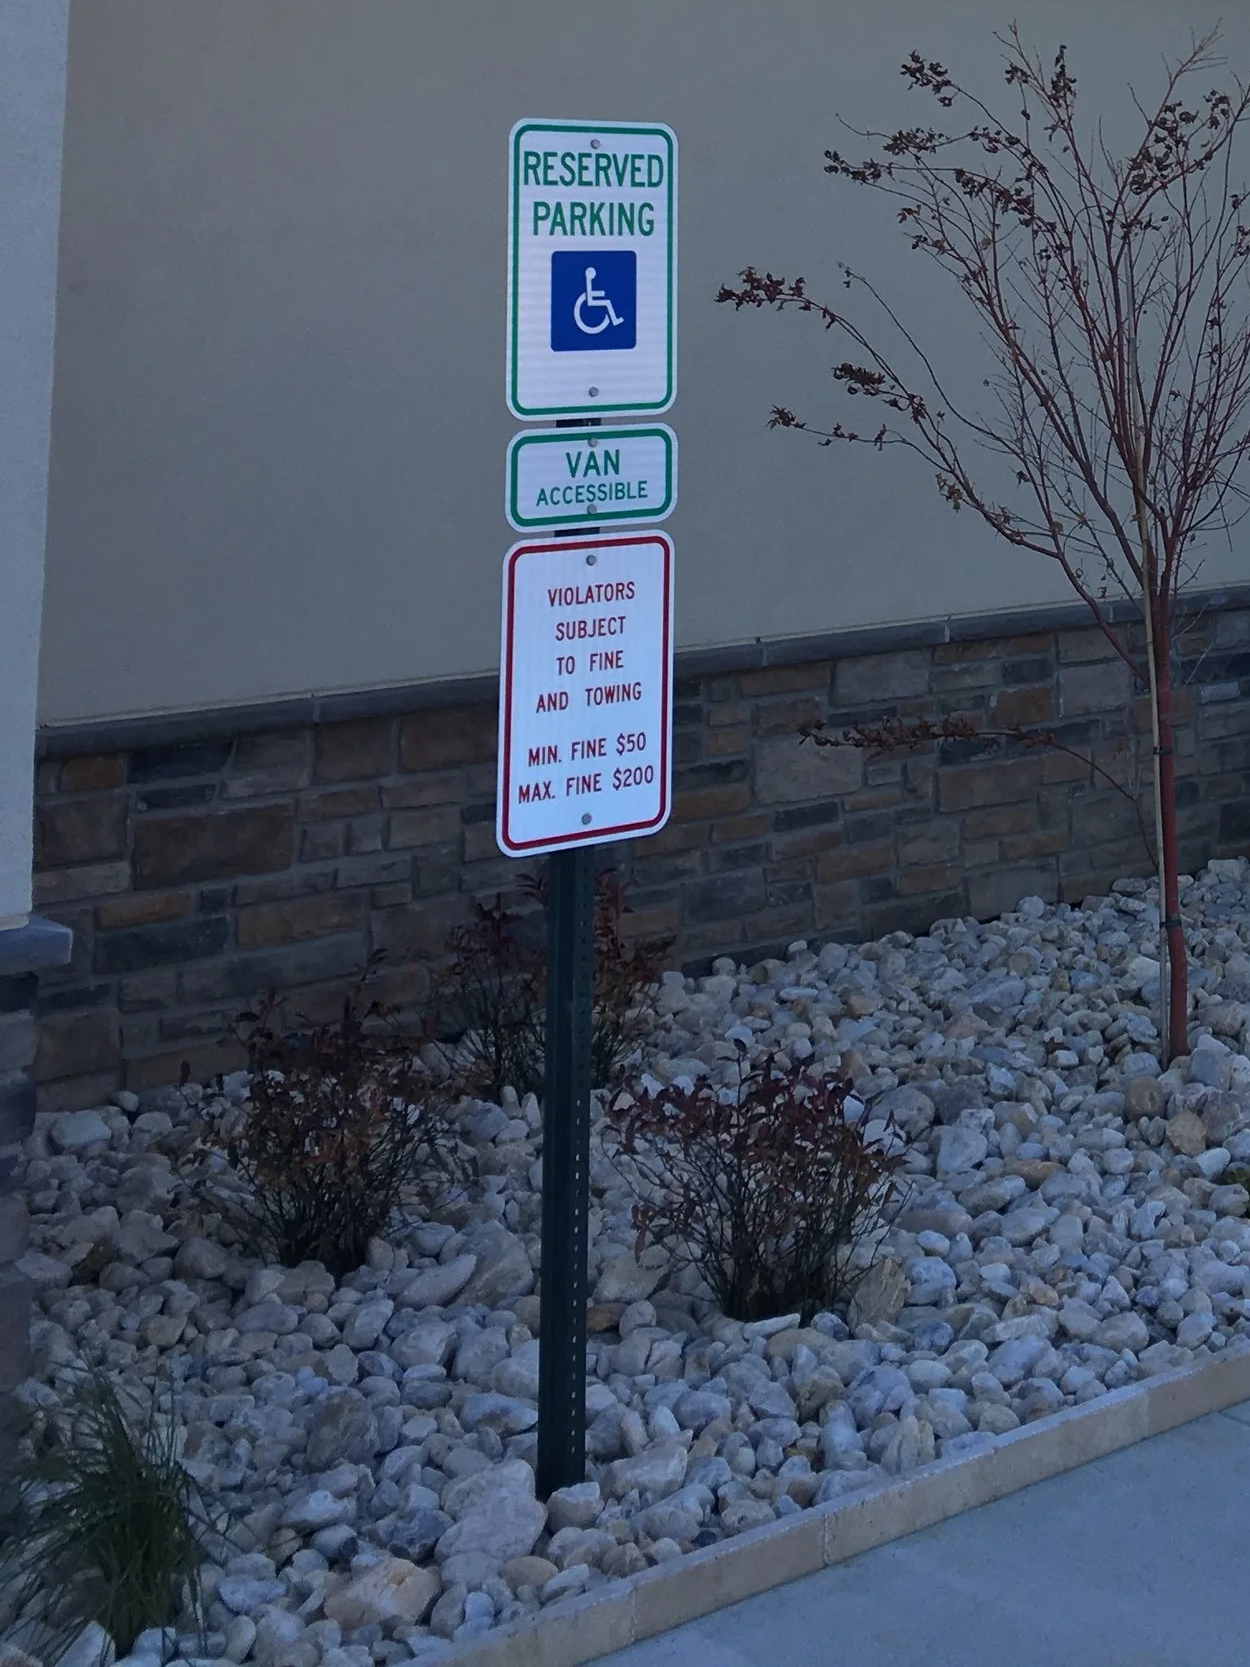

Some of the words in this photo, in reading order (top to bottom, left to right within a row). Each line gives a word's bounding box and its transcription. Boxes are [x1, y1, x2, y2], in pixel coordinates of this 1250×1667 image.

[523, 150, 664, 188] RESERVED
[532, 201, 655, 236] PARKING
[565, 449, 620, 478] VAN
[536, 480, 648, 506] ACCESSIBLE
[548, 581, 635, 607] VIOLATORS
[555, 616, 626, 641] SUBJECT
[556, 656, 575, 675] TO
[589, 650, 624, 672] FINE
[536, 691, 569, 713] AND
[585, 682, 642, 707] TOWING
[528, 745, 562, 767] MIN.
[571, 738, 607, 761] FINE
[616, 732, 646, 756] $50
[518, 780, 555, 804] MAX.
[566, 773, 602, 797] FINE
[612, 765, 654, 791] $200
